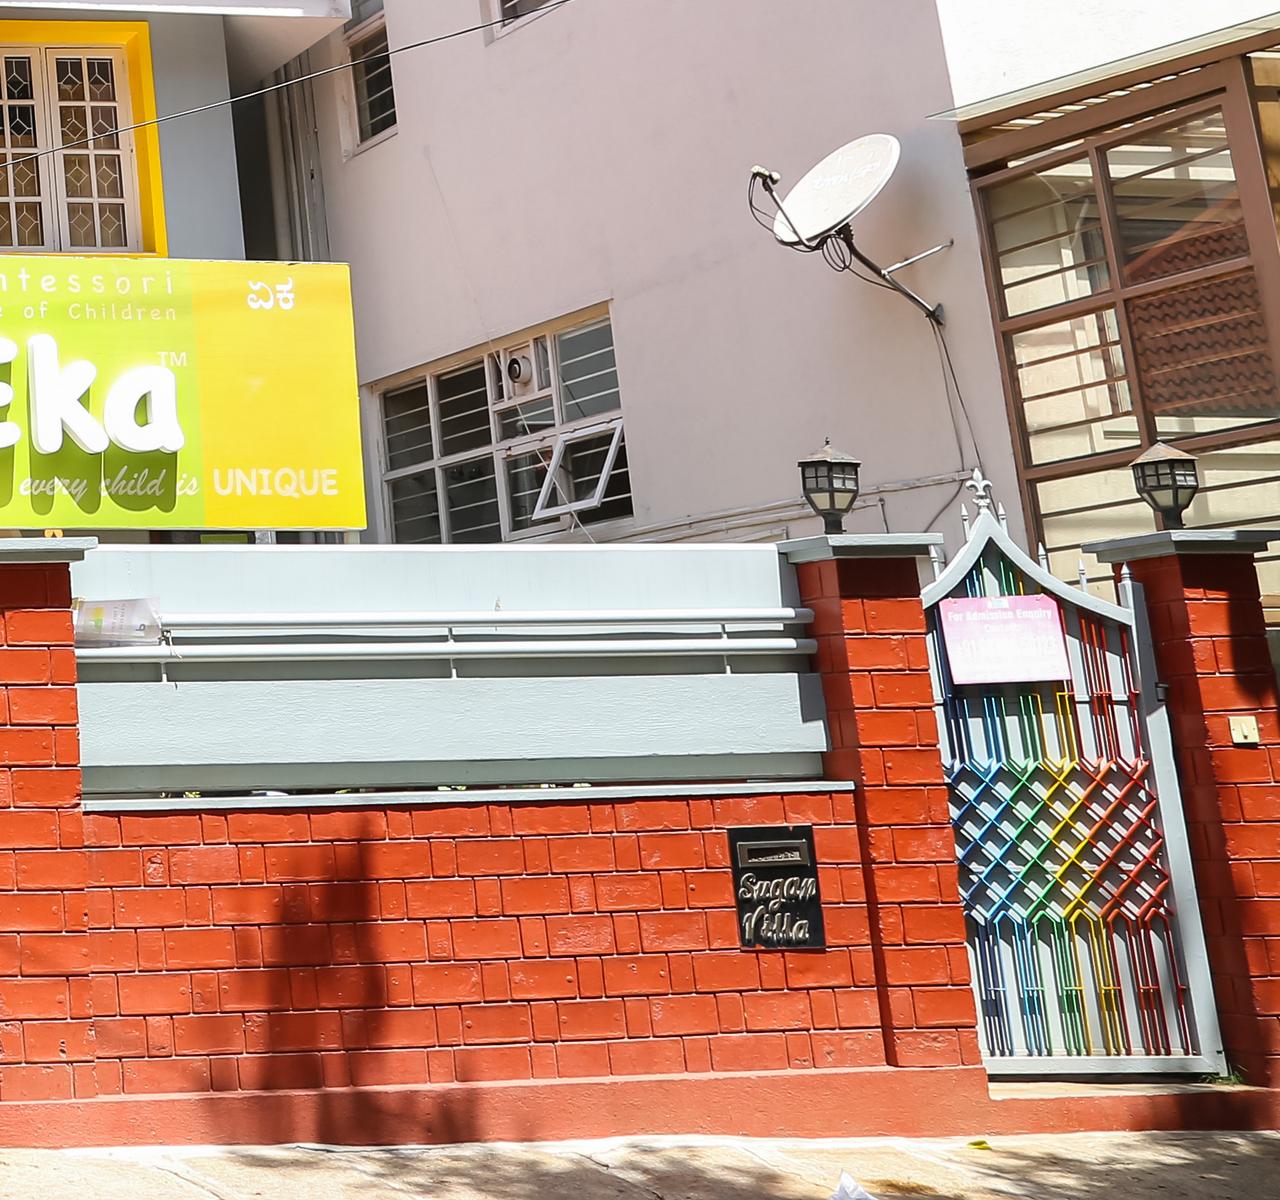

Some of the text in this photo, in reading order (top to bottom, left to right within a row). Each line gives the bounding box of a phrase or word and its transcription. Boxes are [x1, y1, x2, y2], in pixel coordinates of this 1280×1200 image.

[24, 301, 49, 319] of
[68, 303, 176, 322] Children
[19, 465, 340, 503] every child is UNIQUE
